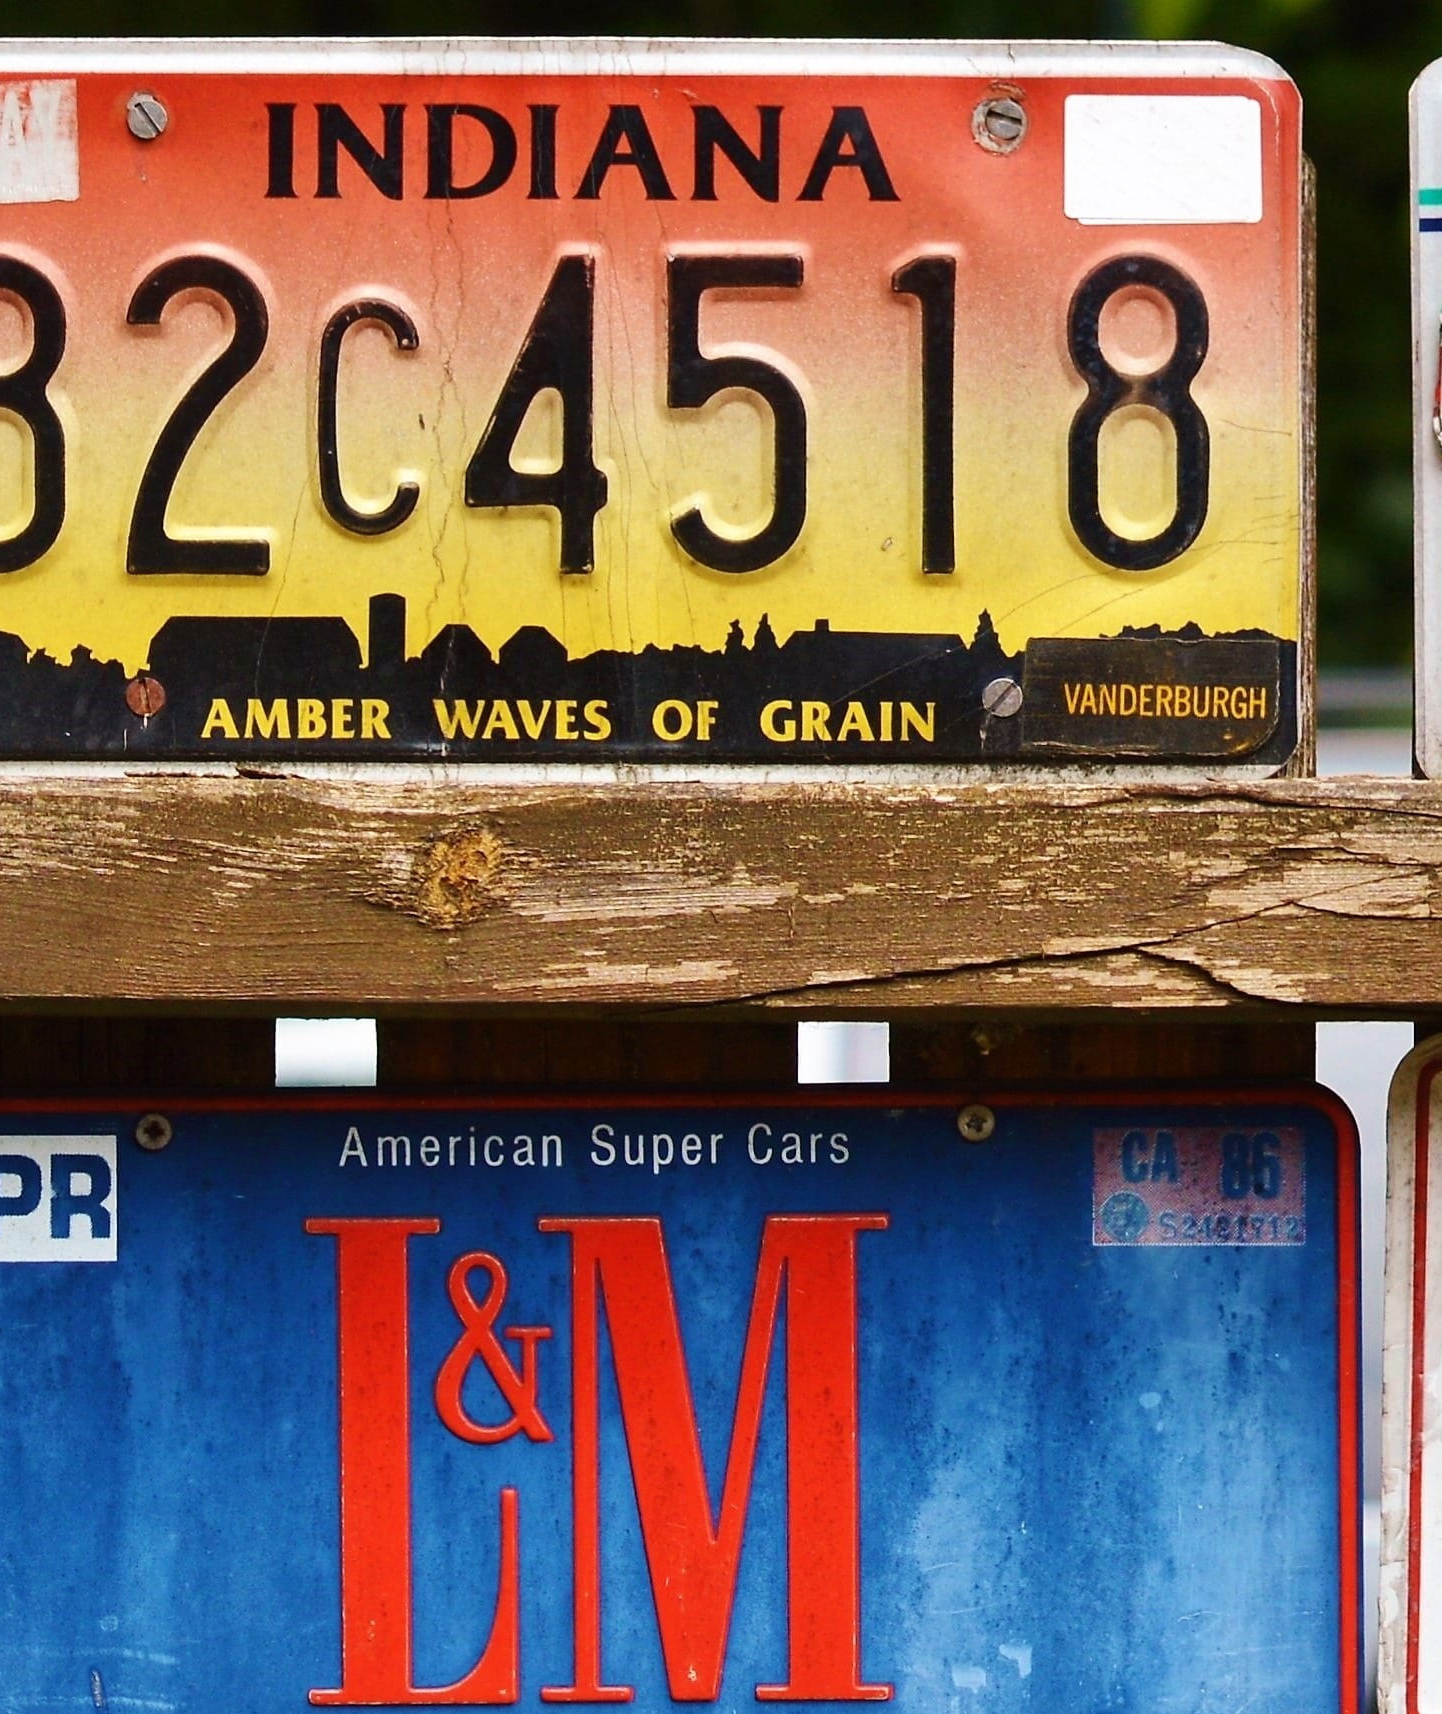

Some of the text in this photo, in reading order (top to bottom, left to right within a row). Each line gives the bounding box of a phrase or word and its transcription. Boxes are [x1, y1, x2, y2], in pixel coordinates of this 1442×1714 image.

[266, 103, 900, 202] INDIANA
[201, 699, 935, 742] AMBER WAVES OF GRAIN
[1065, 683, 1266, 719] VANDERBURGH
[340, 1125, 848, 1174] American Super Cars
[1121, 1129, 1282, 1200] CA 86
[306, 1213, 893, 1705] L&M
